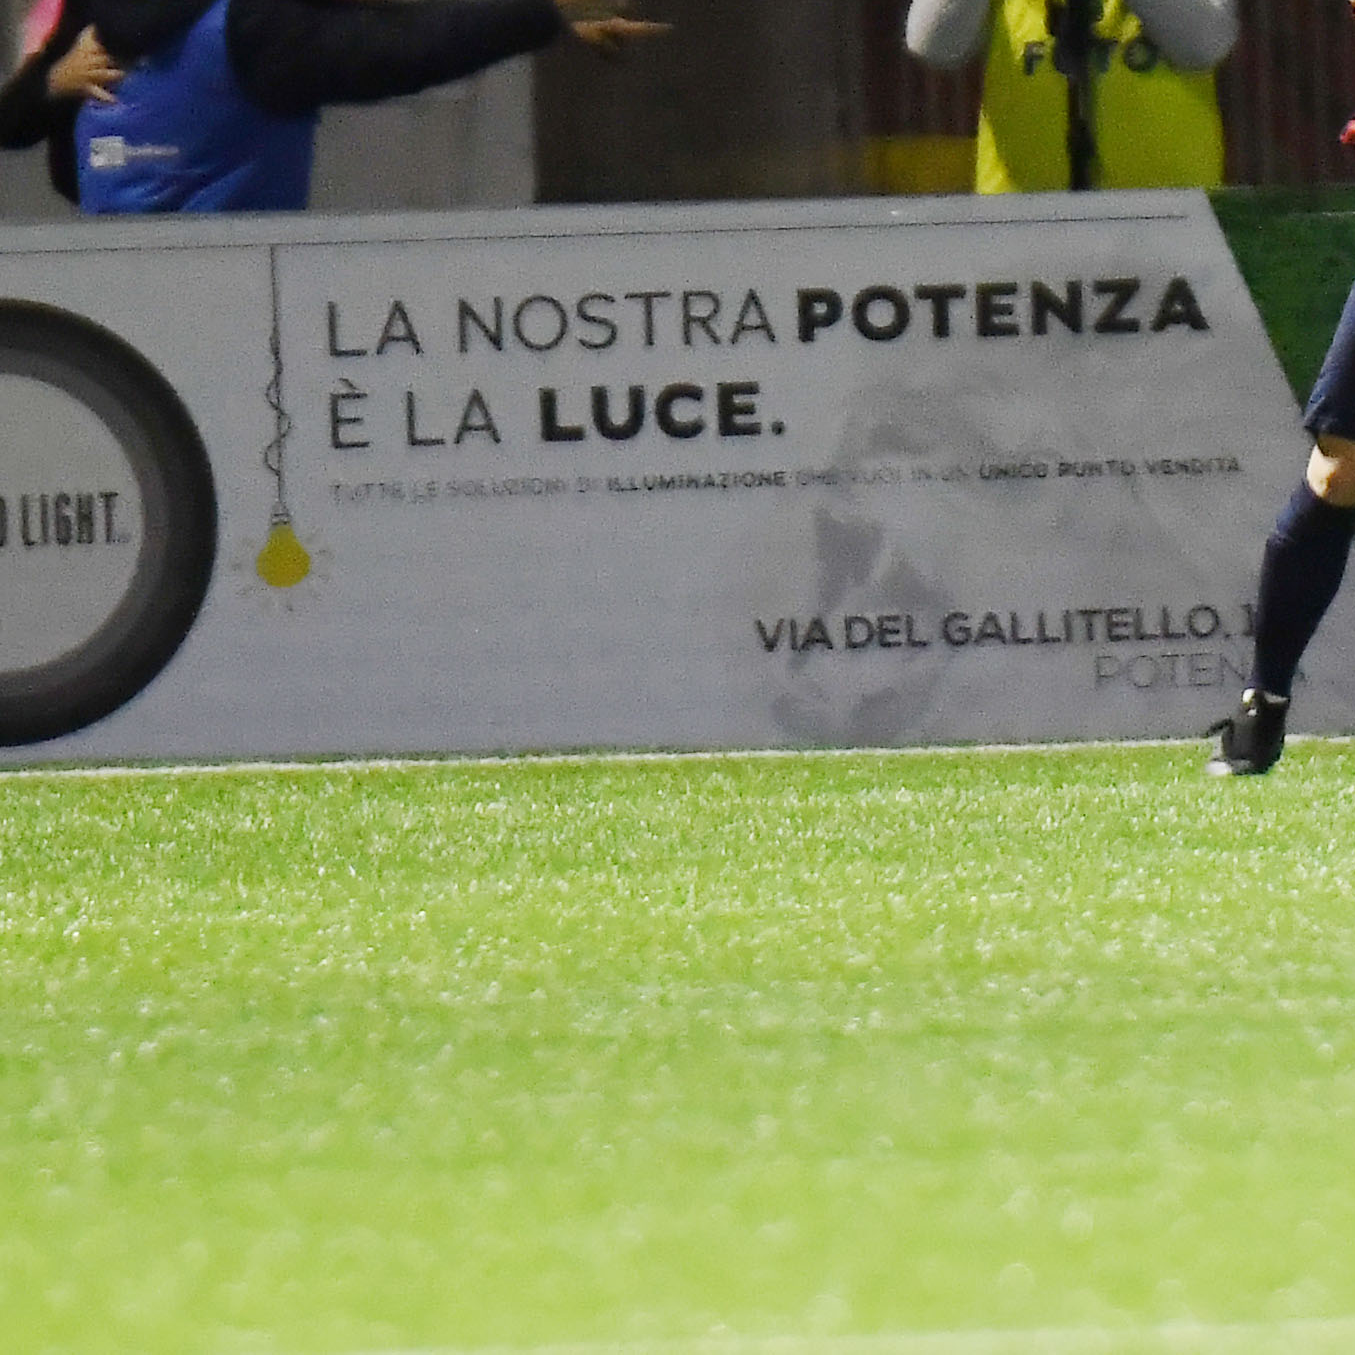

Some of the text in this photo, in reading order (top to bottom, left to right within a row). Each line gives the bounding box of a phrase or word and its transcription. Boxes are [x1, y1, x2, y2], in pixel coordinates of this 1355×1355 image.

[1023, 34, 1160, 75] FTO
[327, 275, 1211, 357] LA NOSTRA POTENZA
[329, 377, 787, 449] È LA LUCE.
[754, 616, 834, 654] VIA
[843, 612, 931, 649] DEL
